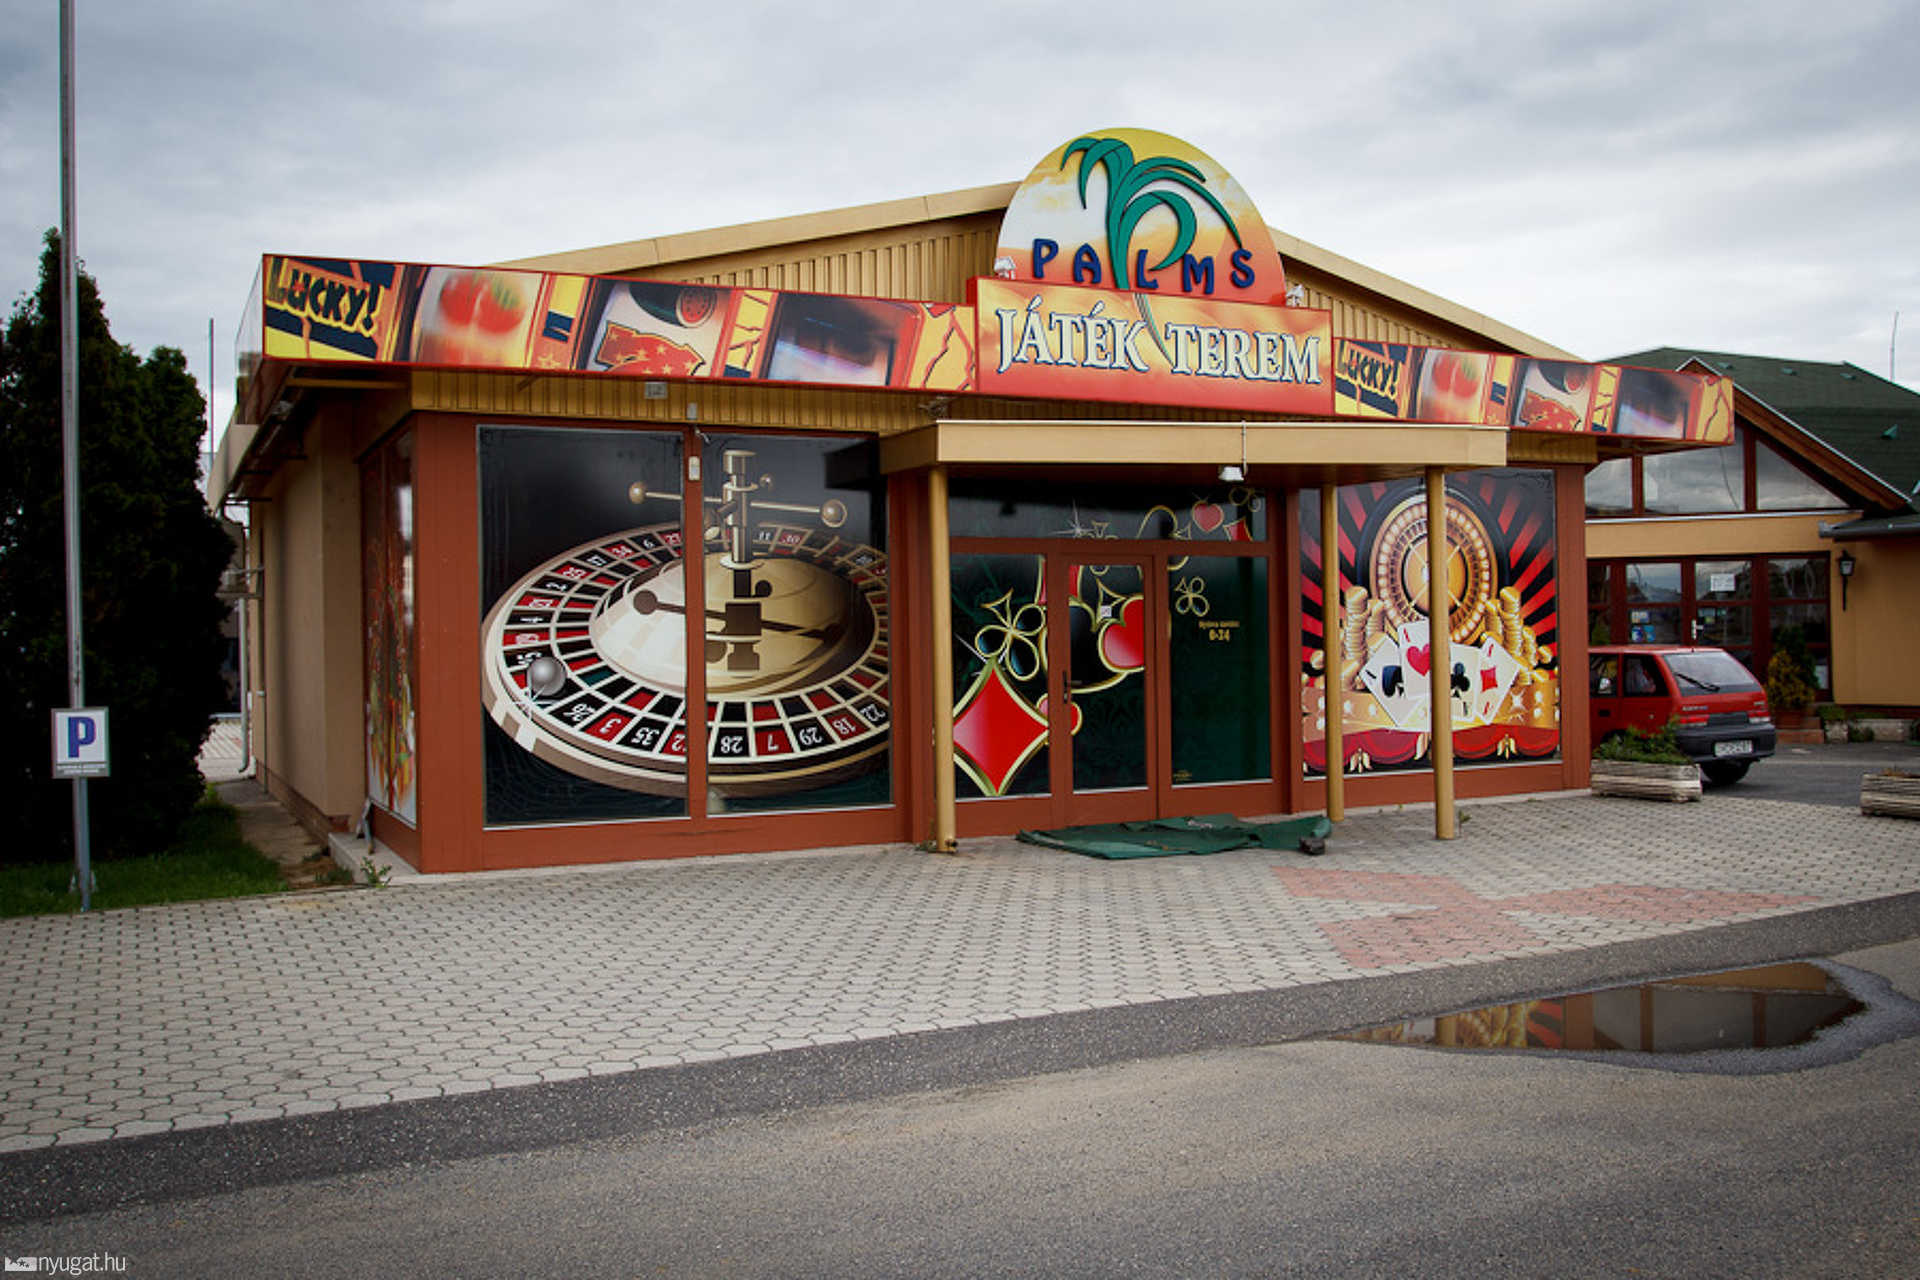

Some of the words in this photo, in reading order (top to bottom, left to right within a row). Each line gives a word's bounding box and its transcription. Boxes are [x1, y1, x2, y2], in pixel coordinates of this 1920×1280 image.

[1032, 239, 1255, 294] PALMS
[268, 257, 380, 331] LUCKY!
[996, 295, 1149, 374] JÁTÉK
[1165, 322, 1321, 384] TEREM
[1337, 340, 1399, 396] LUCKY!
[68, 716, 96, 758] P
[631, 727, 660, 746] 35
[720, 735, 744, 753] 28
[800, 727, 822, 746] 29
